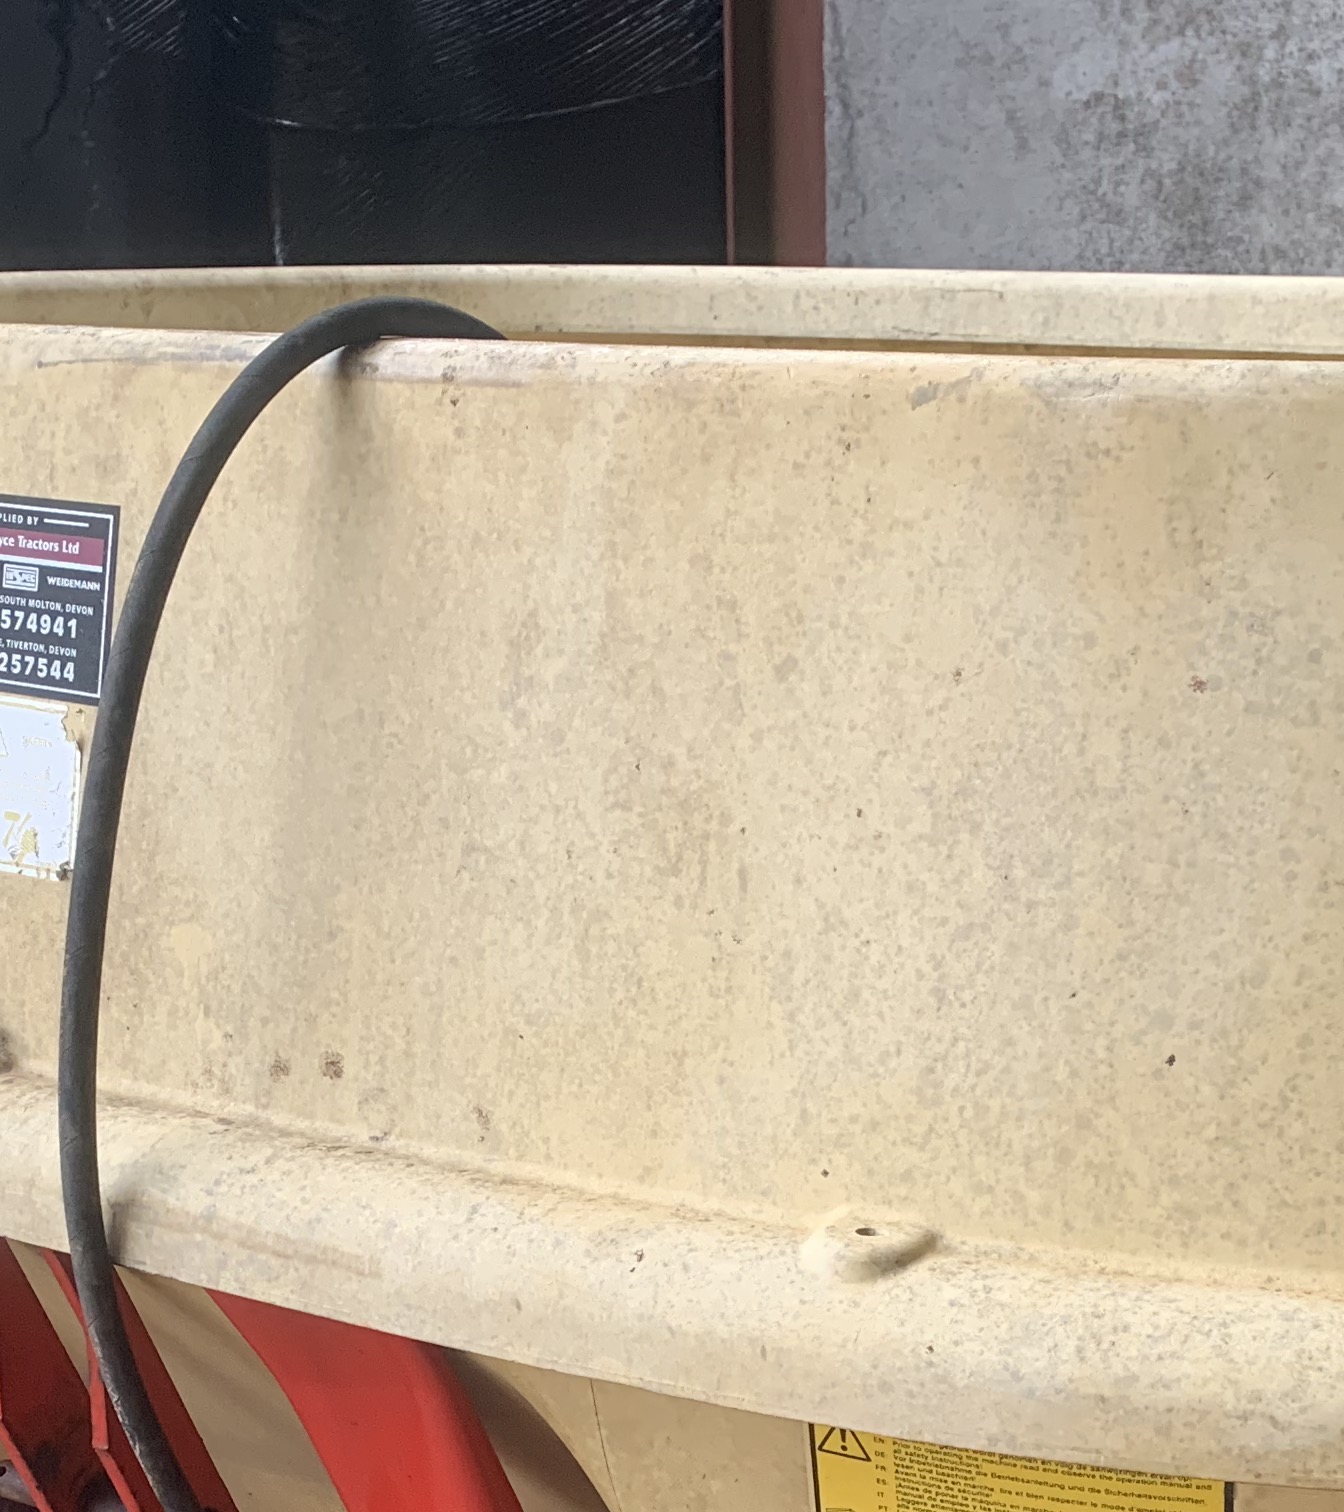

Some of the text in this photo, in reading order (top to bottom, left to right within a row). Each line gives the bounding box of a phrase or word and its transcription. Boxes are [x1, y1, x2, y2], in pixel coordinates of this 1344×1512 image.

[27, 516, 39, 526] BY
[18, 535, 59, 552] Tractors
[62, 540, 79, 554] Ltd
[47, 576, 101, 591] WEIDEMANN
[0, 595, 26, 606] SOUTH
[28, 598, 64, 613] MOLTON,
[66, 603, 93, 616] DEVON
[0, 608, 77, 639] 574941
[6, 639, 47, 654] TIVERTON,
[49, 645, 77, 657] DEVON
